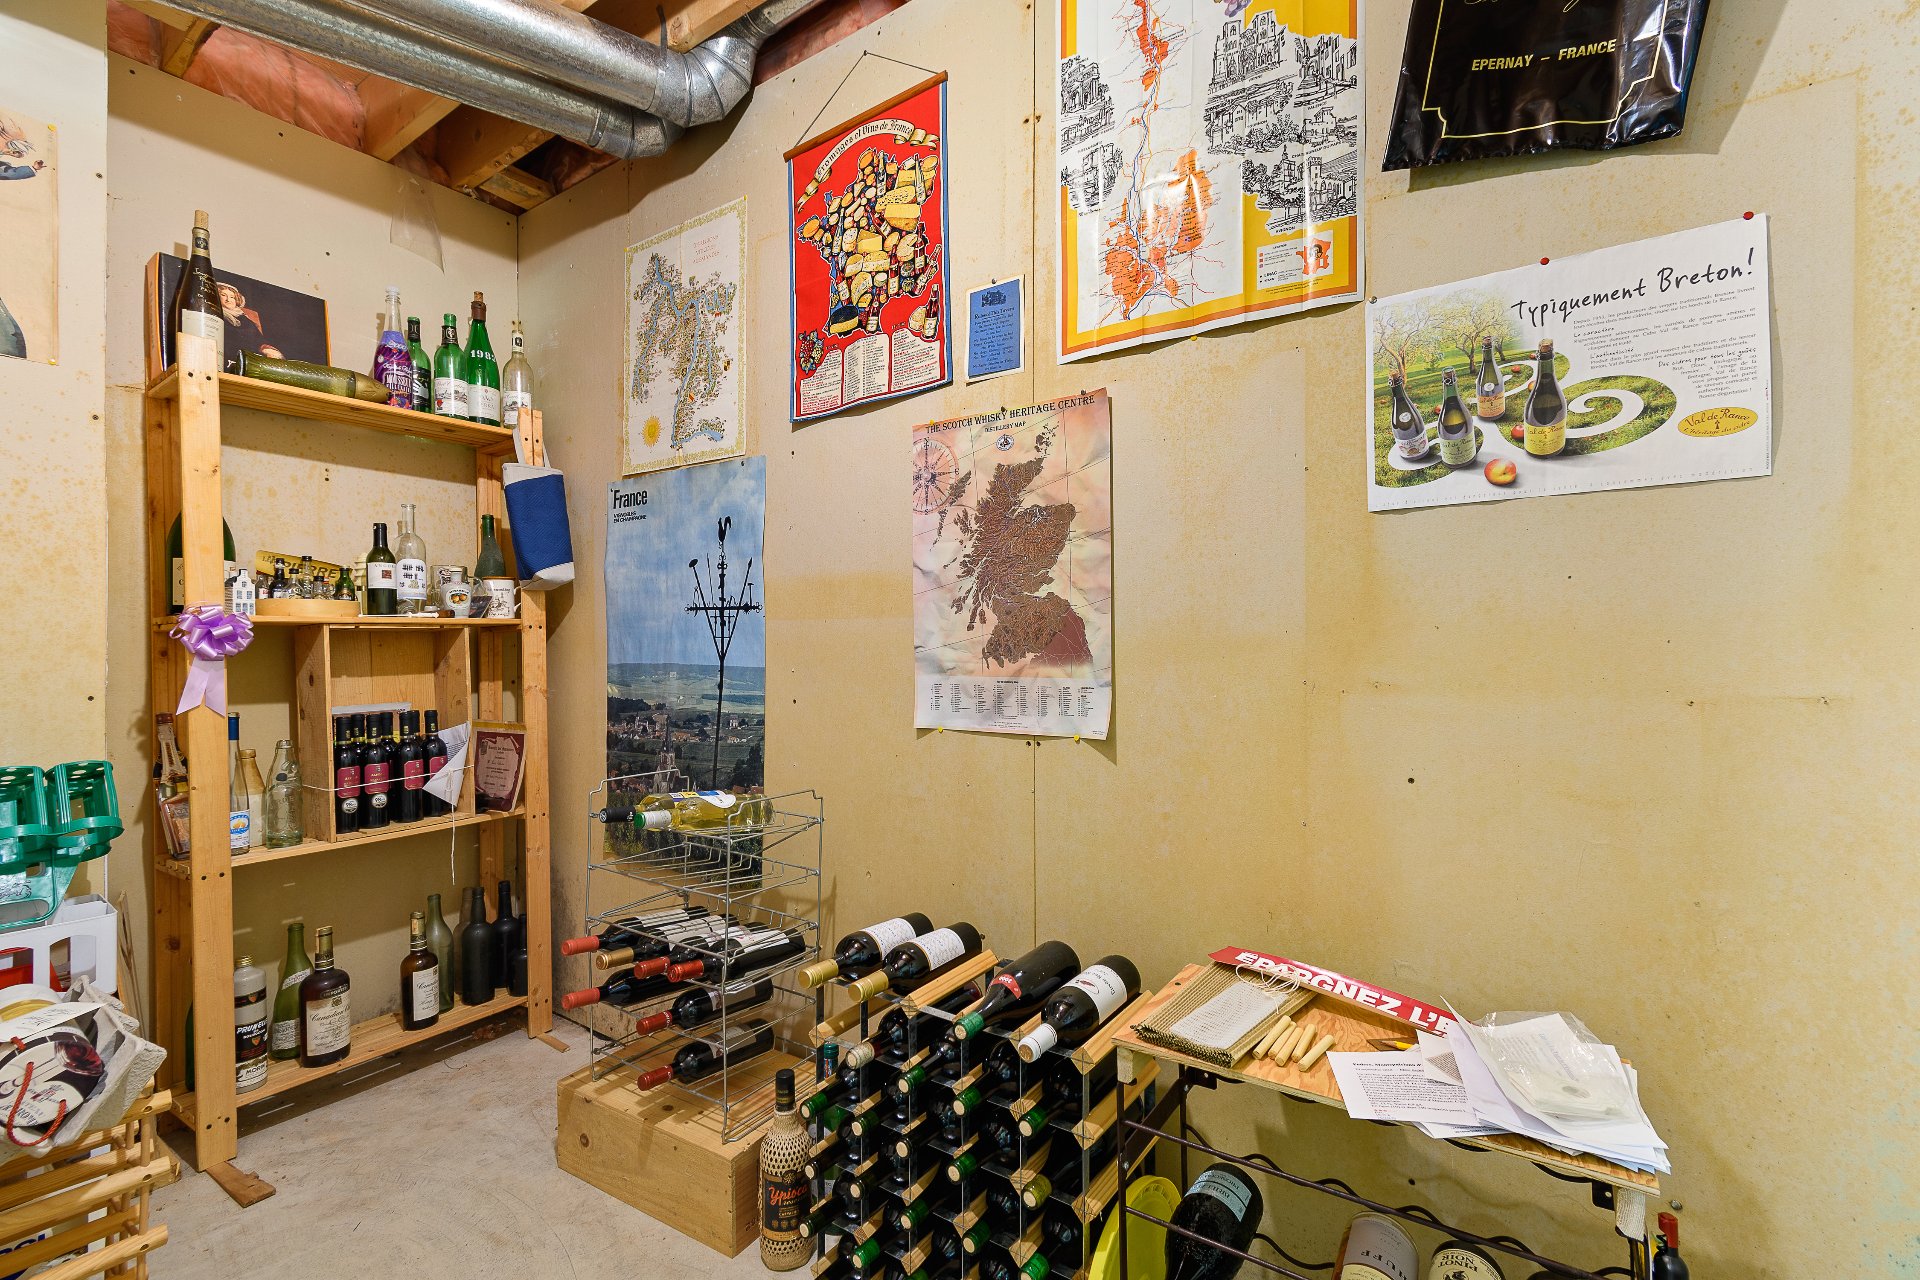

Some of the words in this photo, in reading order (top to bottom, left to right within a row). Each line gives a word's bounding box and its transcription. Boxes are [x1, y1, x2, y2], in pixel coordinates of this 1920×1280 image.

[1471, 54, 1533, 71] EPERNAY
[1558, 38, 1617, 61] FRANCE
[855, 129, 862, 140] et
[879, 121, 888, 131] de
[888, 119, 913, 135] France
[1511, 278, 1646, 328] Typiquement
[1657, 247, 1754, 293] Breton!
[926, 422, 941, 434] THE
[942, 415, 973, 431] SCOTCH
[974, 409, 1008, 426] WHISKY
[1009, 402, 1056, 419] HERITAGE
[1058, 394, 1095, 410] CENTRE
[1685, 412, 1706, 427] Val
[1707, 411, 1718, 421] de
[1720, 408, 1750, 421] Rance
[984, 422, 1014, 433] DISTILLERY
[1014, 420, 1027, 429] MAP
[613, 489, 648, 509] France
[619, 514, 647, 524] CHAMPAGNE
[1235, 951, 1402, 1016] ÉPARGNEZ
[310, 1008, 344, 1022] Canadian
[1437, 1259, 1479, 1273] PINOT
[1440, 1253, 1476, 1265] NOIR
